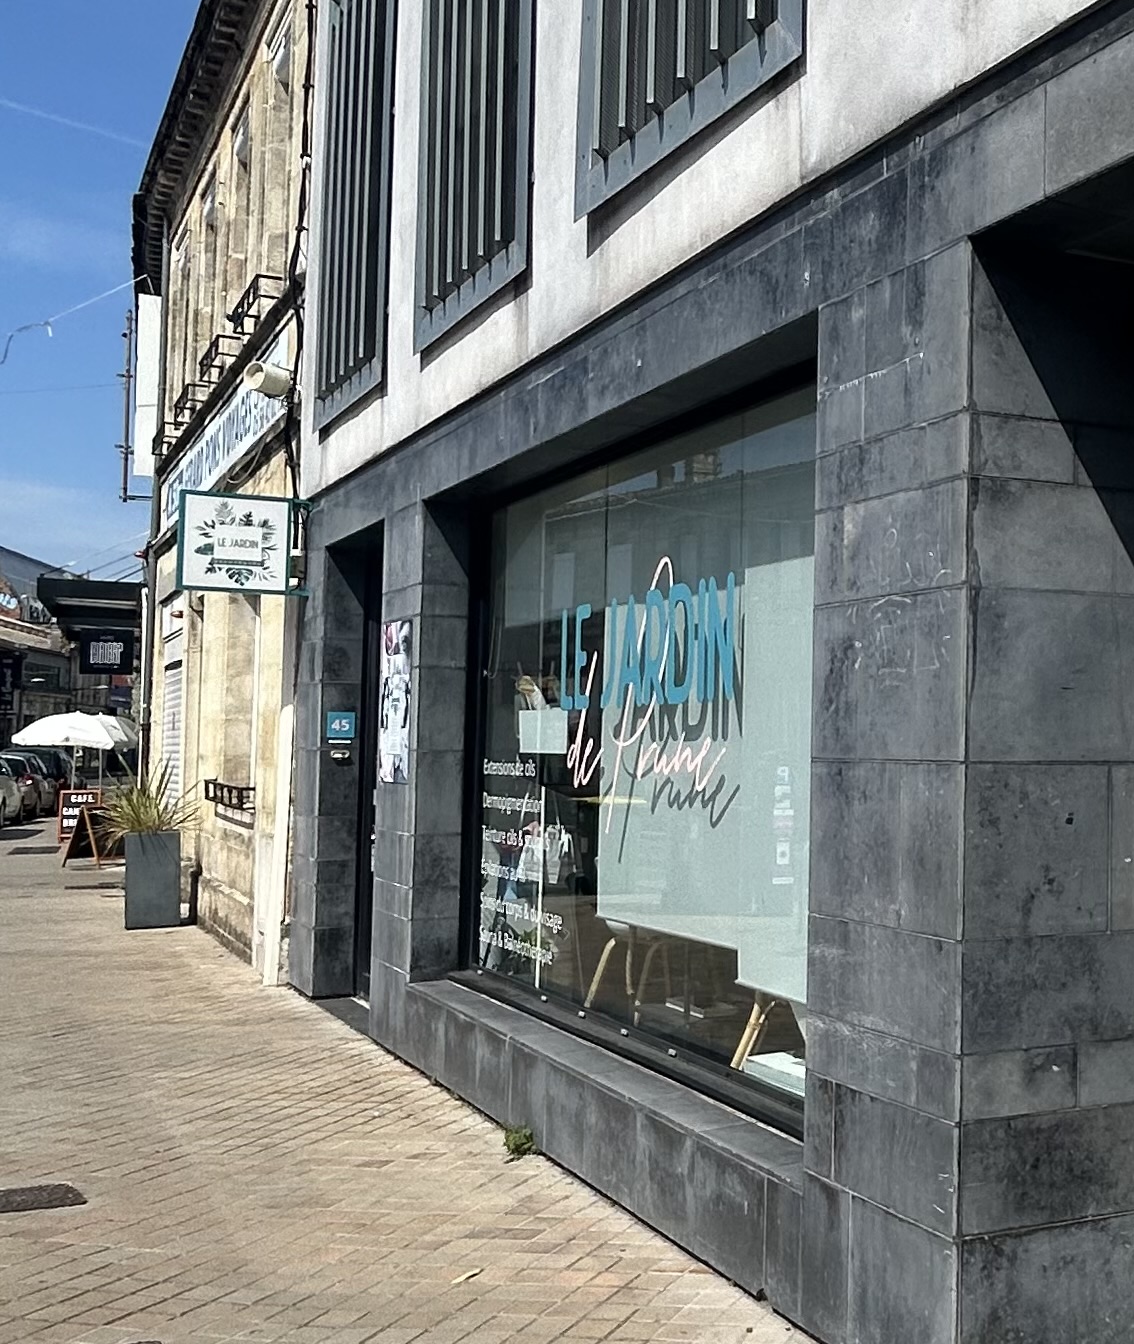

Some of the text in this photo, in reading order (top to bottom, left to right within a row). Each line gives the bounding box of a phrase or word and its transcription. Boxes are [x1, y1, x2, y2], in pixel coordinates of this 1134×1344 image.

[217, 538, 259, 548] LE JARDIN
[560, 571, 736, 711] LE JARDIN
[331, 719, 350, 731] 45
[566, 555, 726, 834] de Prune
